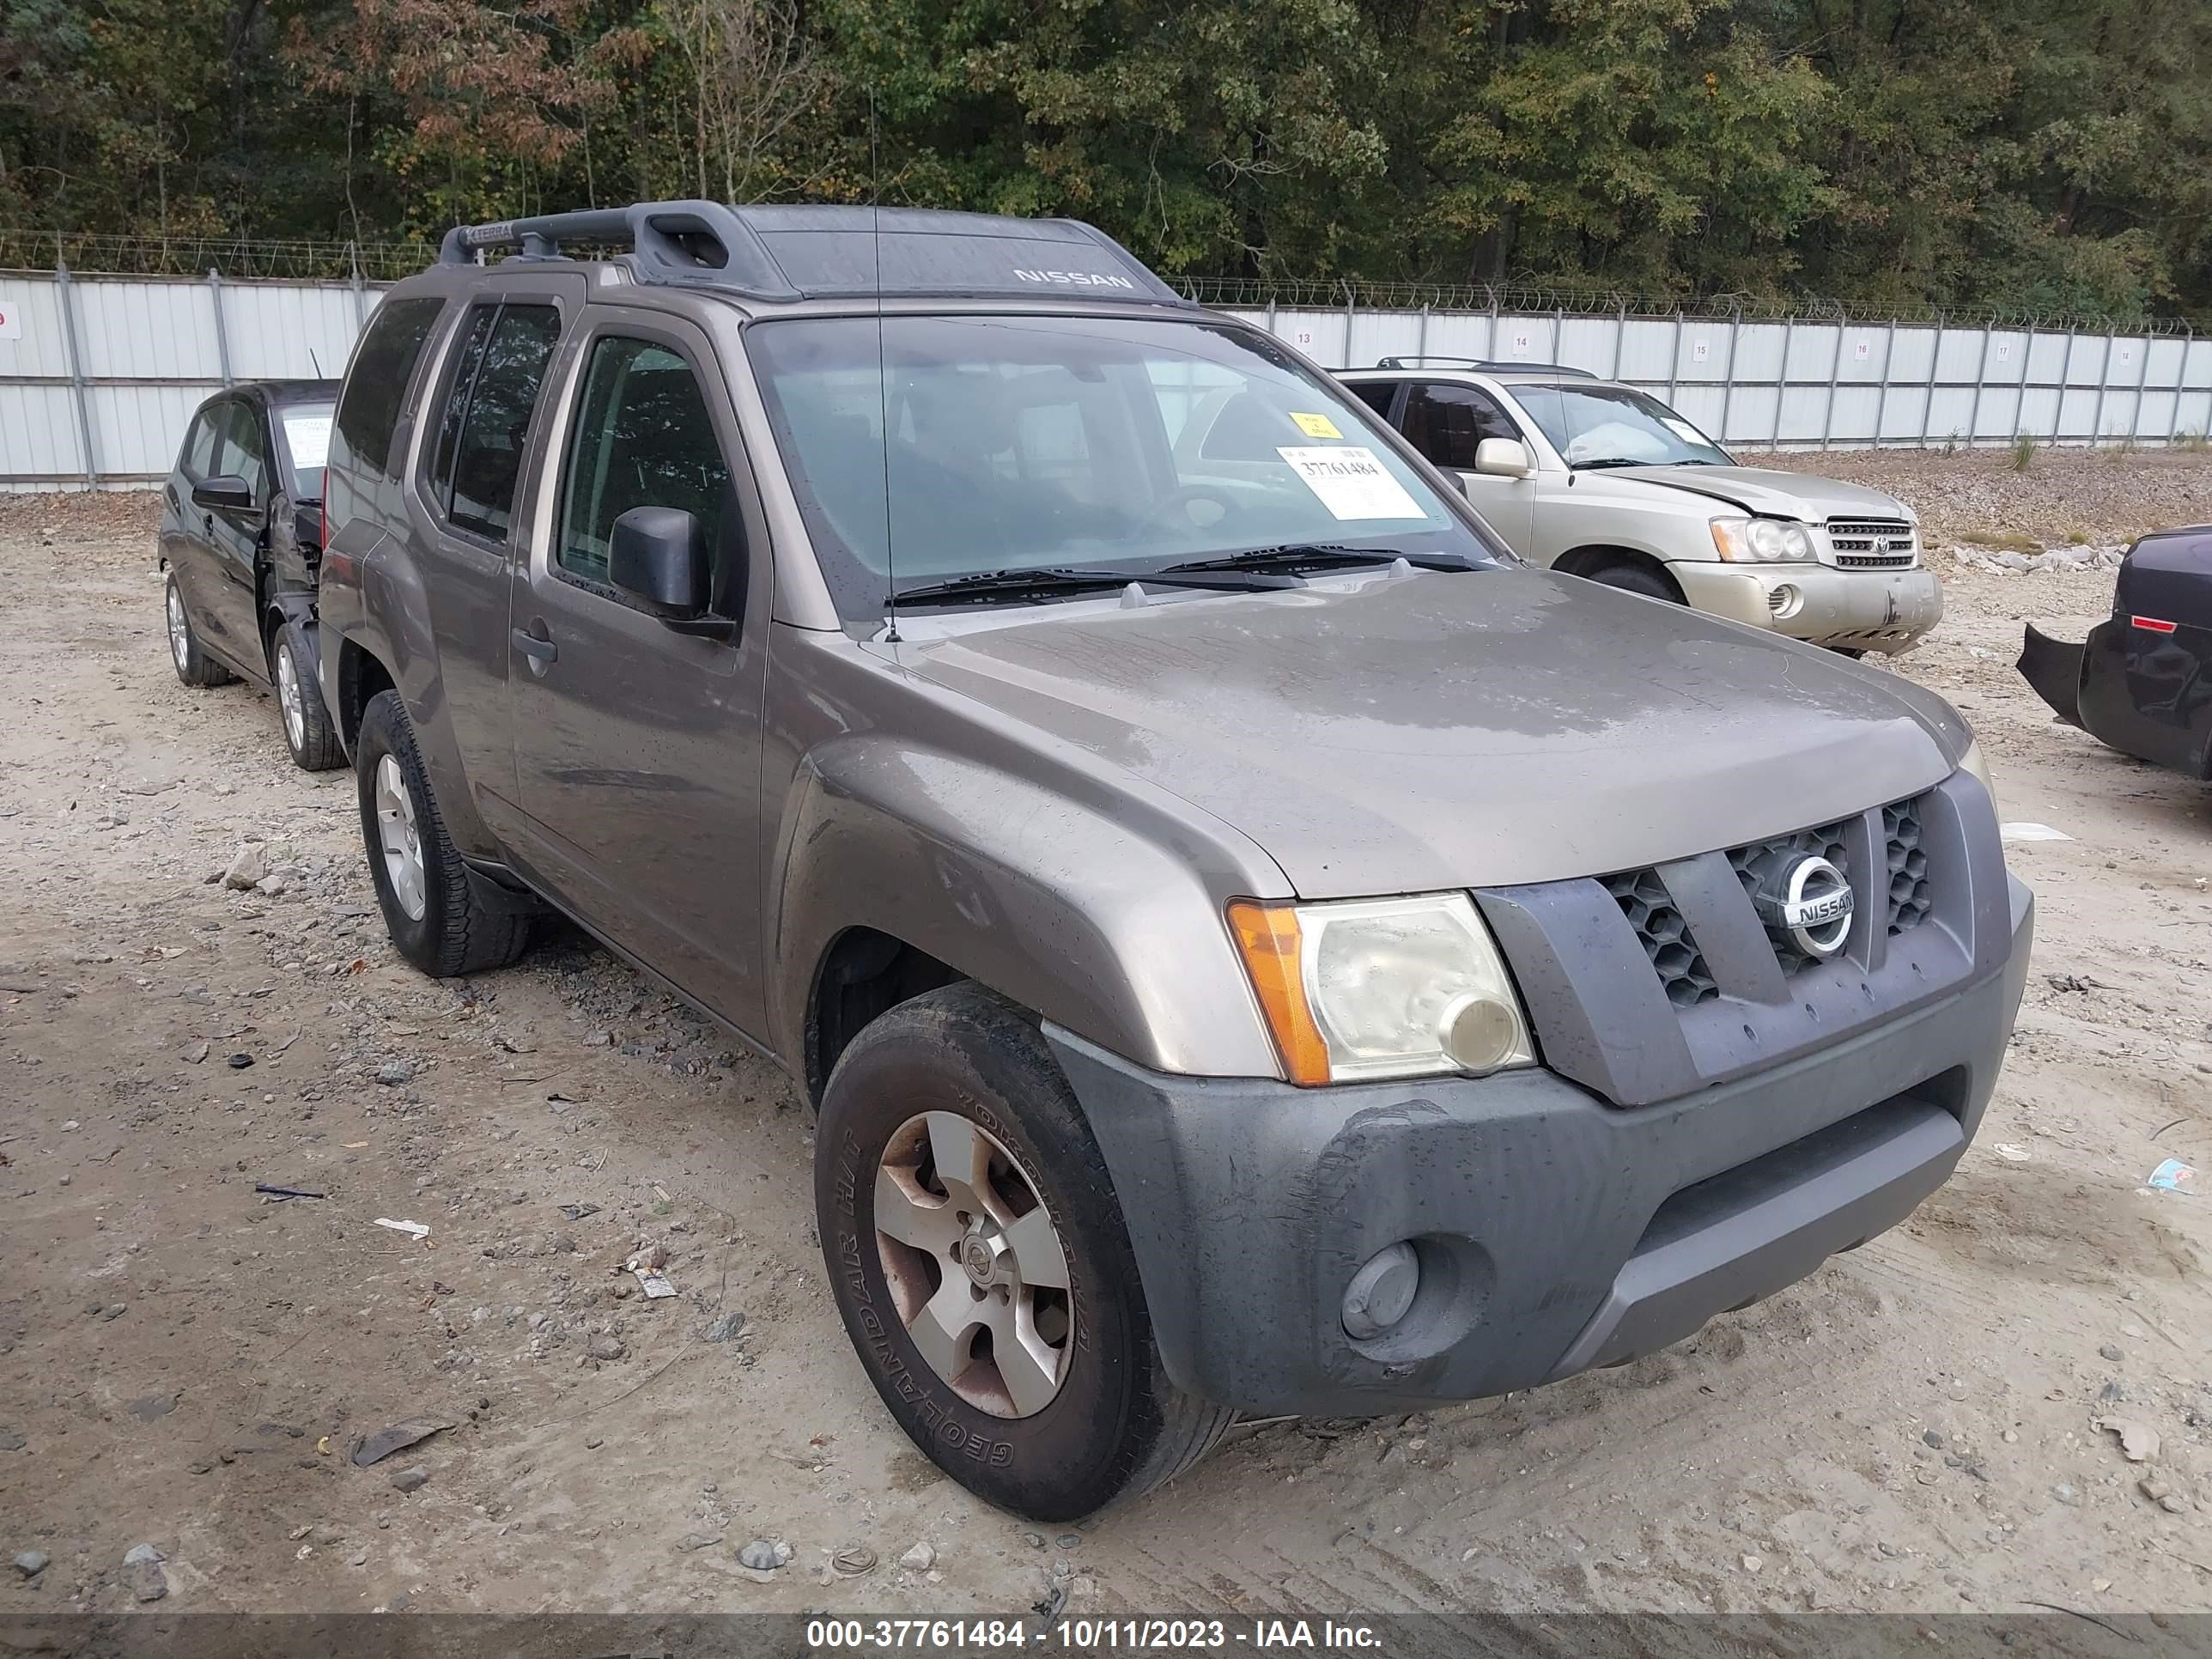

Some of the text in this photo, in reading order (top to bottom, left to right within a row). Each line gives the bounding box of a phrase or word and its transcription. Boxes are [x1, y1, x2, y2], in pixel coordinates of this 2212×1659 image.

[1012, 269, 1134, 289] NISSAN
[1297, 333, 1310, 343] 13
[1516, 337, 1527, 347] 14
[1697, 346, 1706, 355] 15
[2000, 347, 2008, 356] 17
[1301, 462, 1380, 477] 37761484
[1799, 892, 1853, 922] NISSAN
[839, 1230, 1013, 1468] GEOLANDAR
